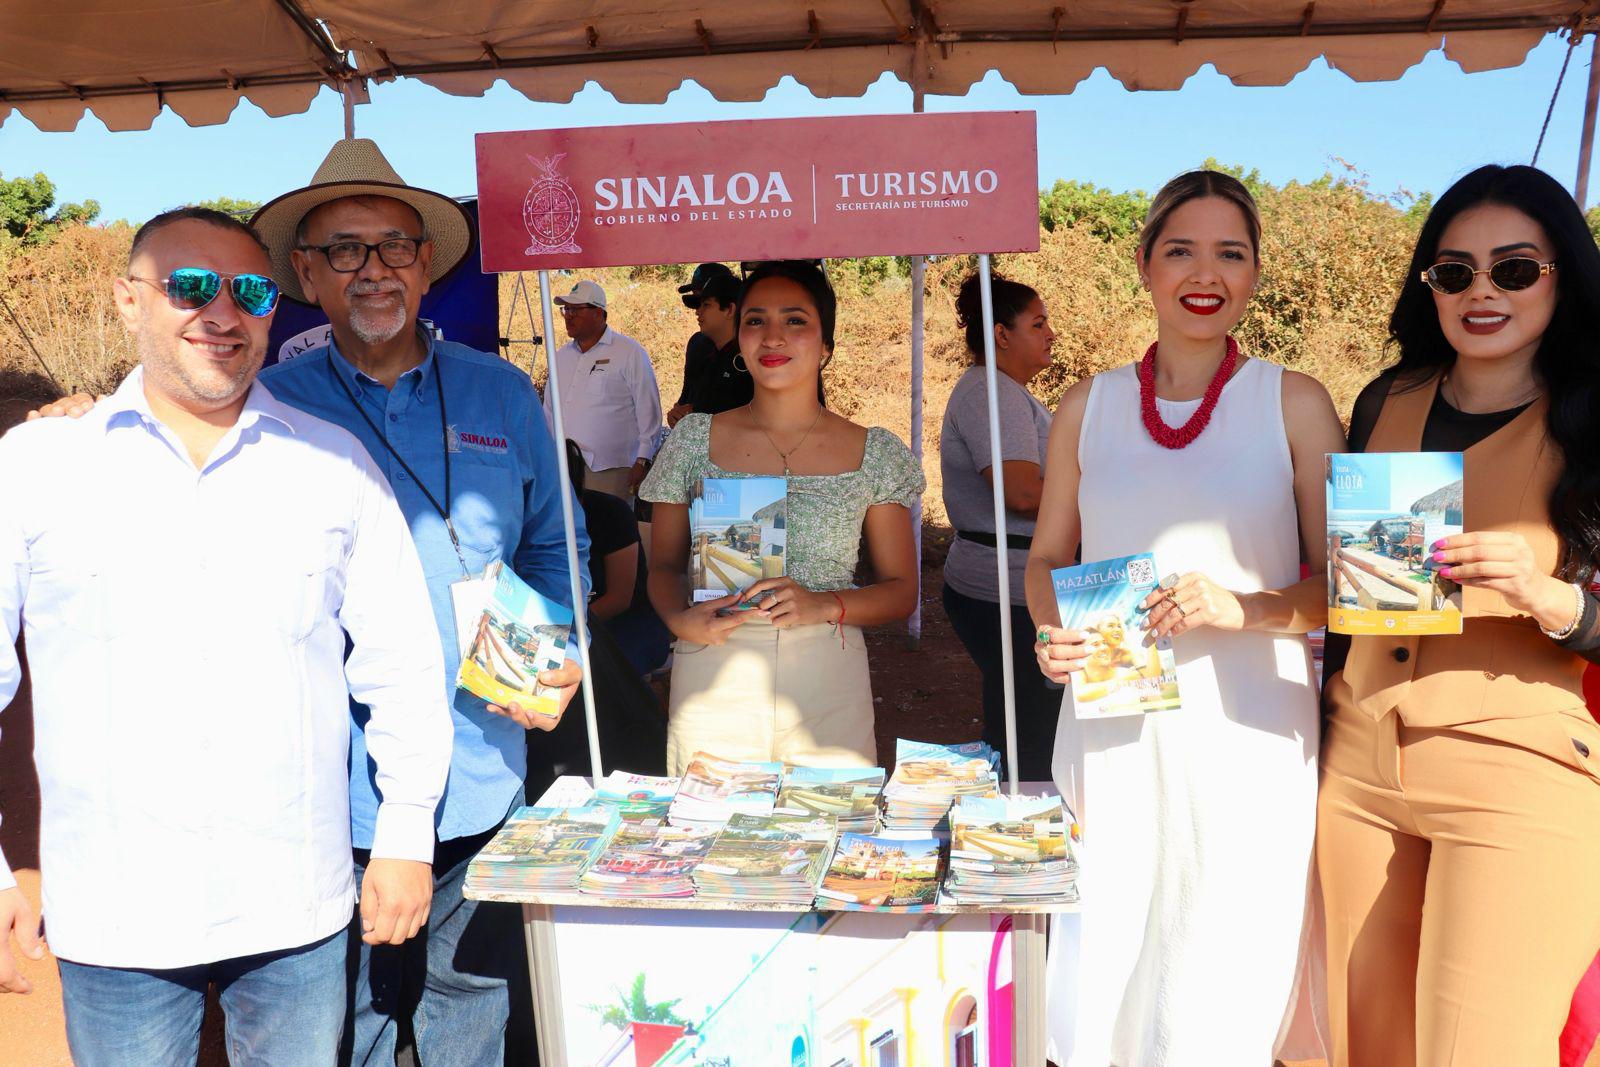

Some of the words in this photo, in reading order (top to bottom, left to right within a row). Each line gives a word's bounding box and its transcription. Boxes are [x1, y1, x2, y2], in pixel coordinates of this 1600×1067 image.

[594, 171, 793, 211] SINALOA
[834, 169, 998, 198] TURISMO
[835, 200, 900, 211] SECRETARÍA
[903, 201, 917, 209] DE
[920, 199, 969, 209] TURISMO
[594, 213, 681, 226] GOBIERNO
[689, 211, 719, 221] DEL
[728, 208, 792, 220] ESTADO
[460, 431, 508, 449] SINALOA
[1056, 568, 1126, 590] MAZATLÁN
